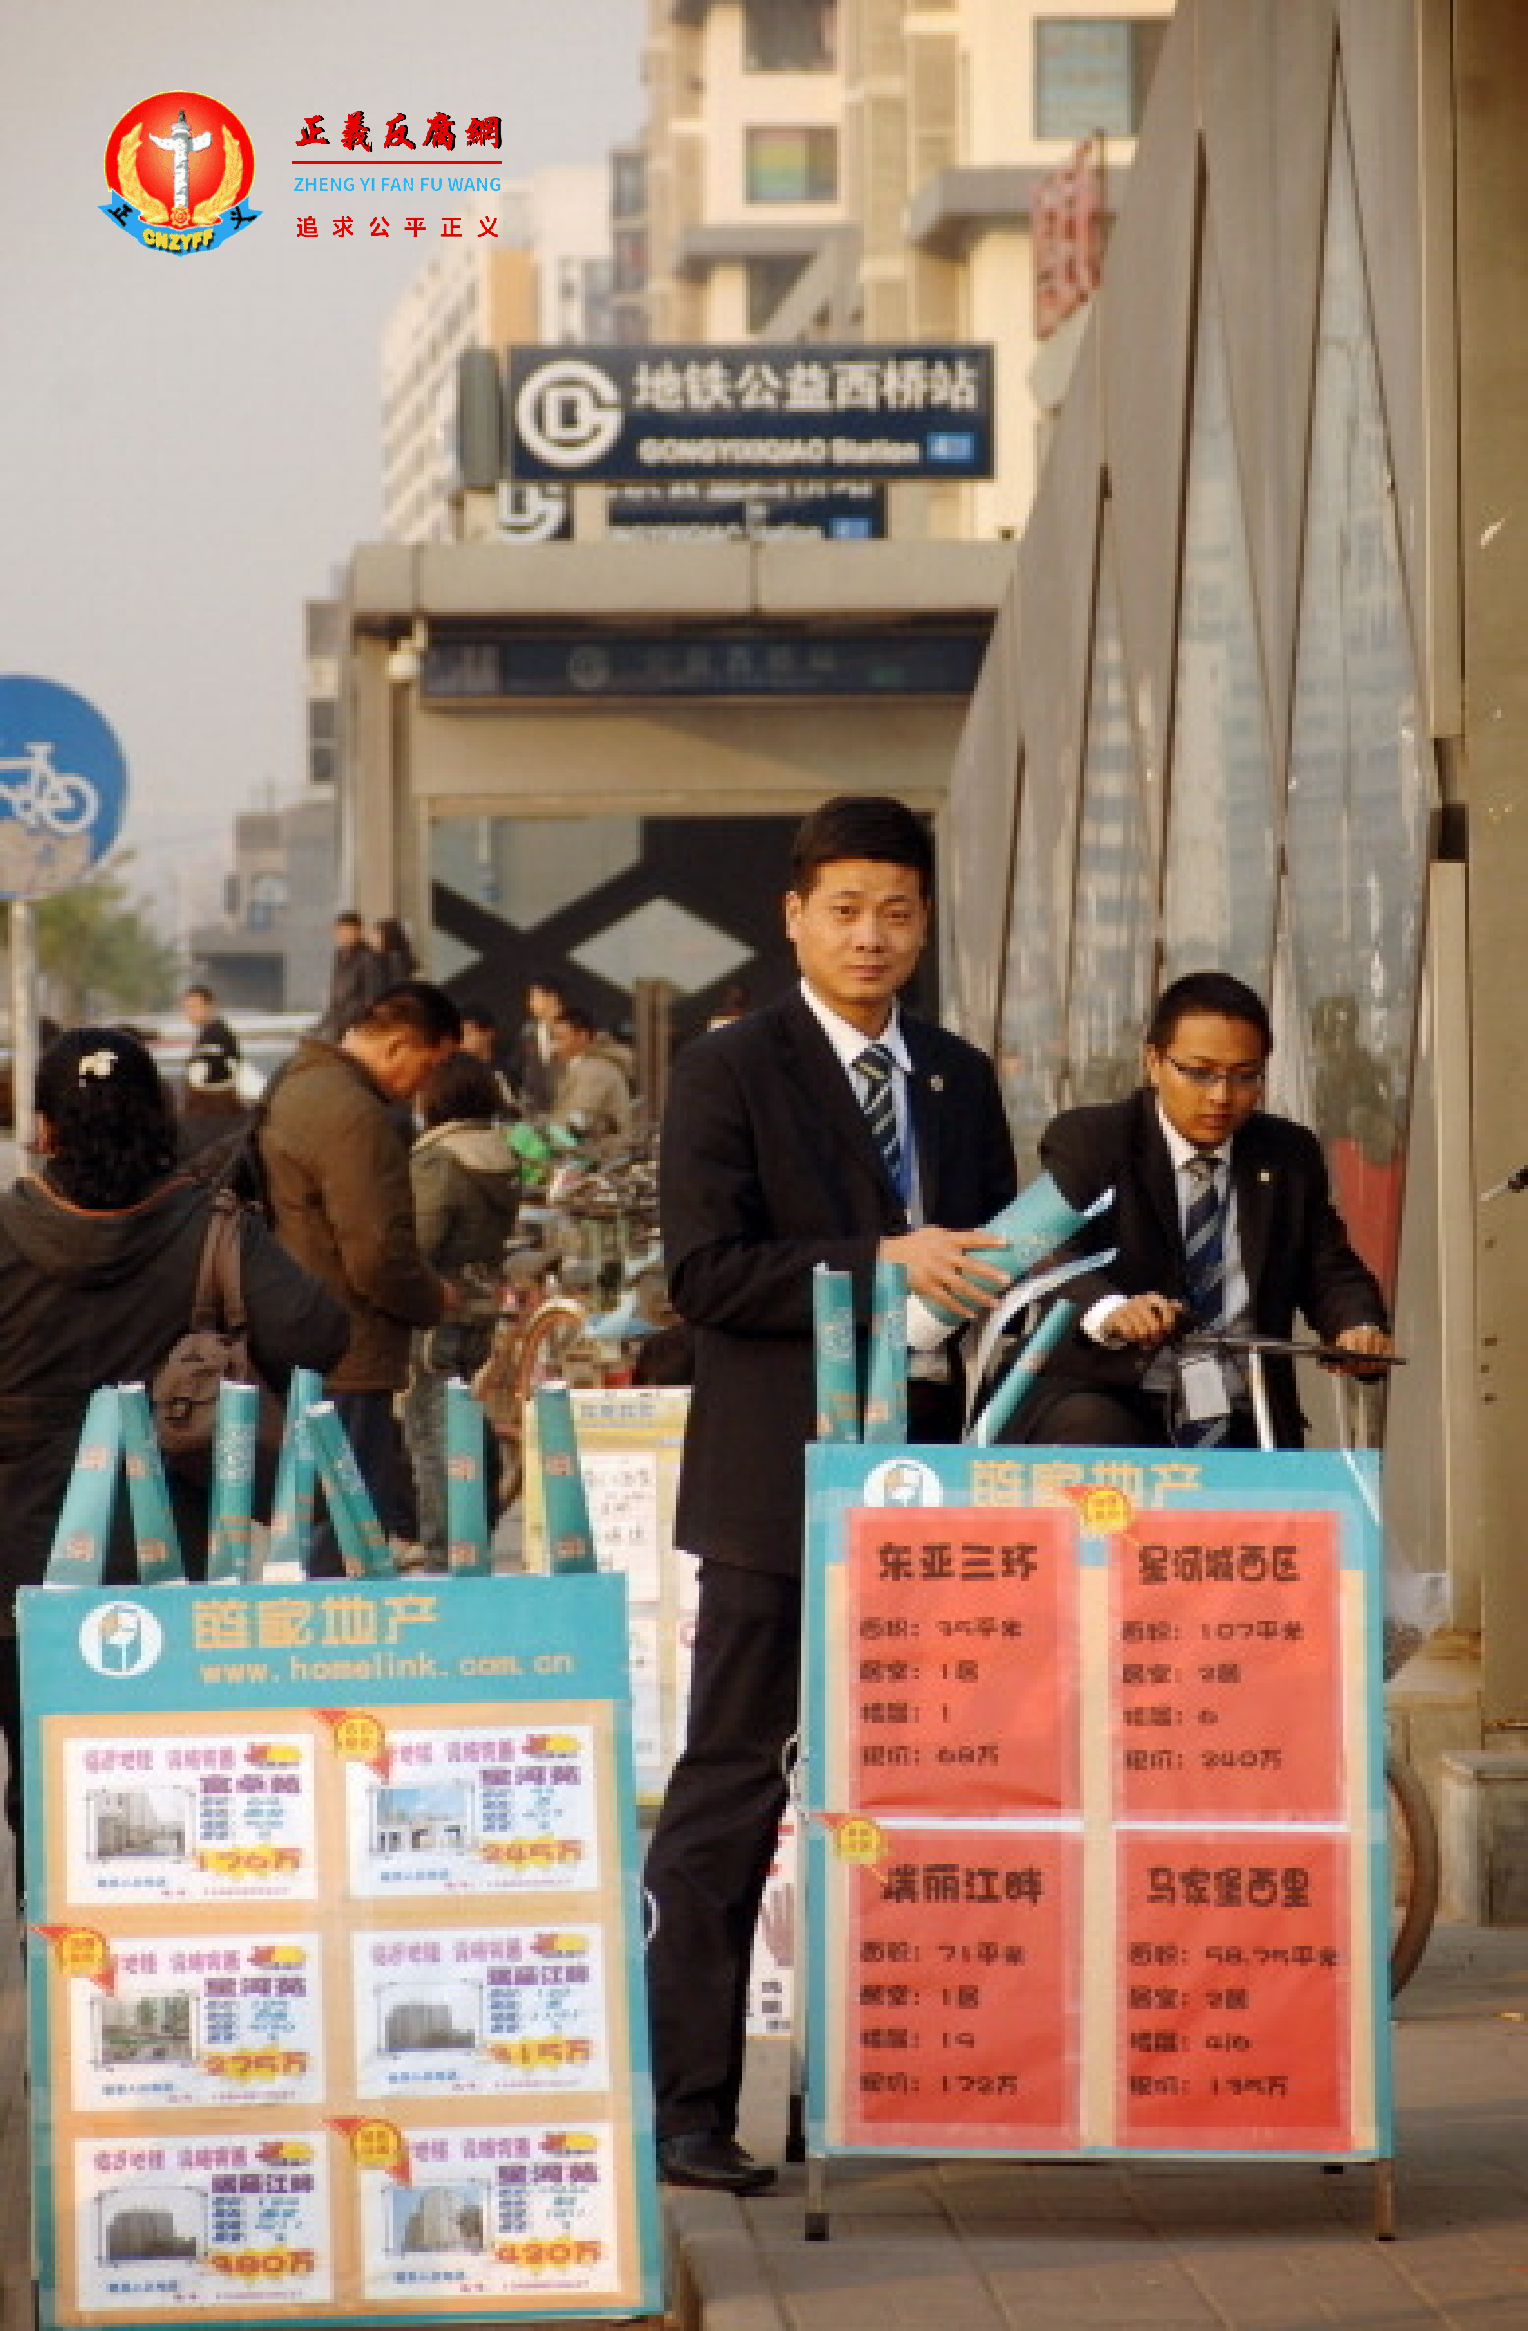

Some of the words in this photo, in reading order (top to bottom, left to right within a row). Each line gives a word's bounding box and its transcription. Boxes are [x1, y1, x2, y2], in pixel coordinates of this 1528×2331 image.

[632, 360, 981, 411] 地铁公益西桥站
[832, 437, 920, 464] Station
[876, 1541, 1038, 1582] 东亚三环
[1147, 1866, 1310, 1910] 马家堡西里
